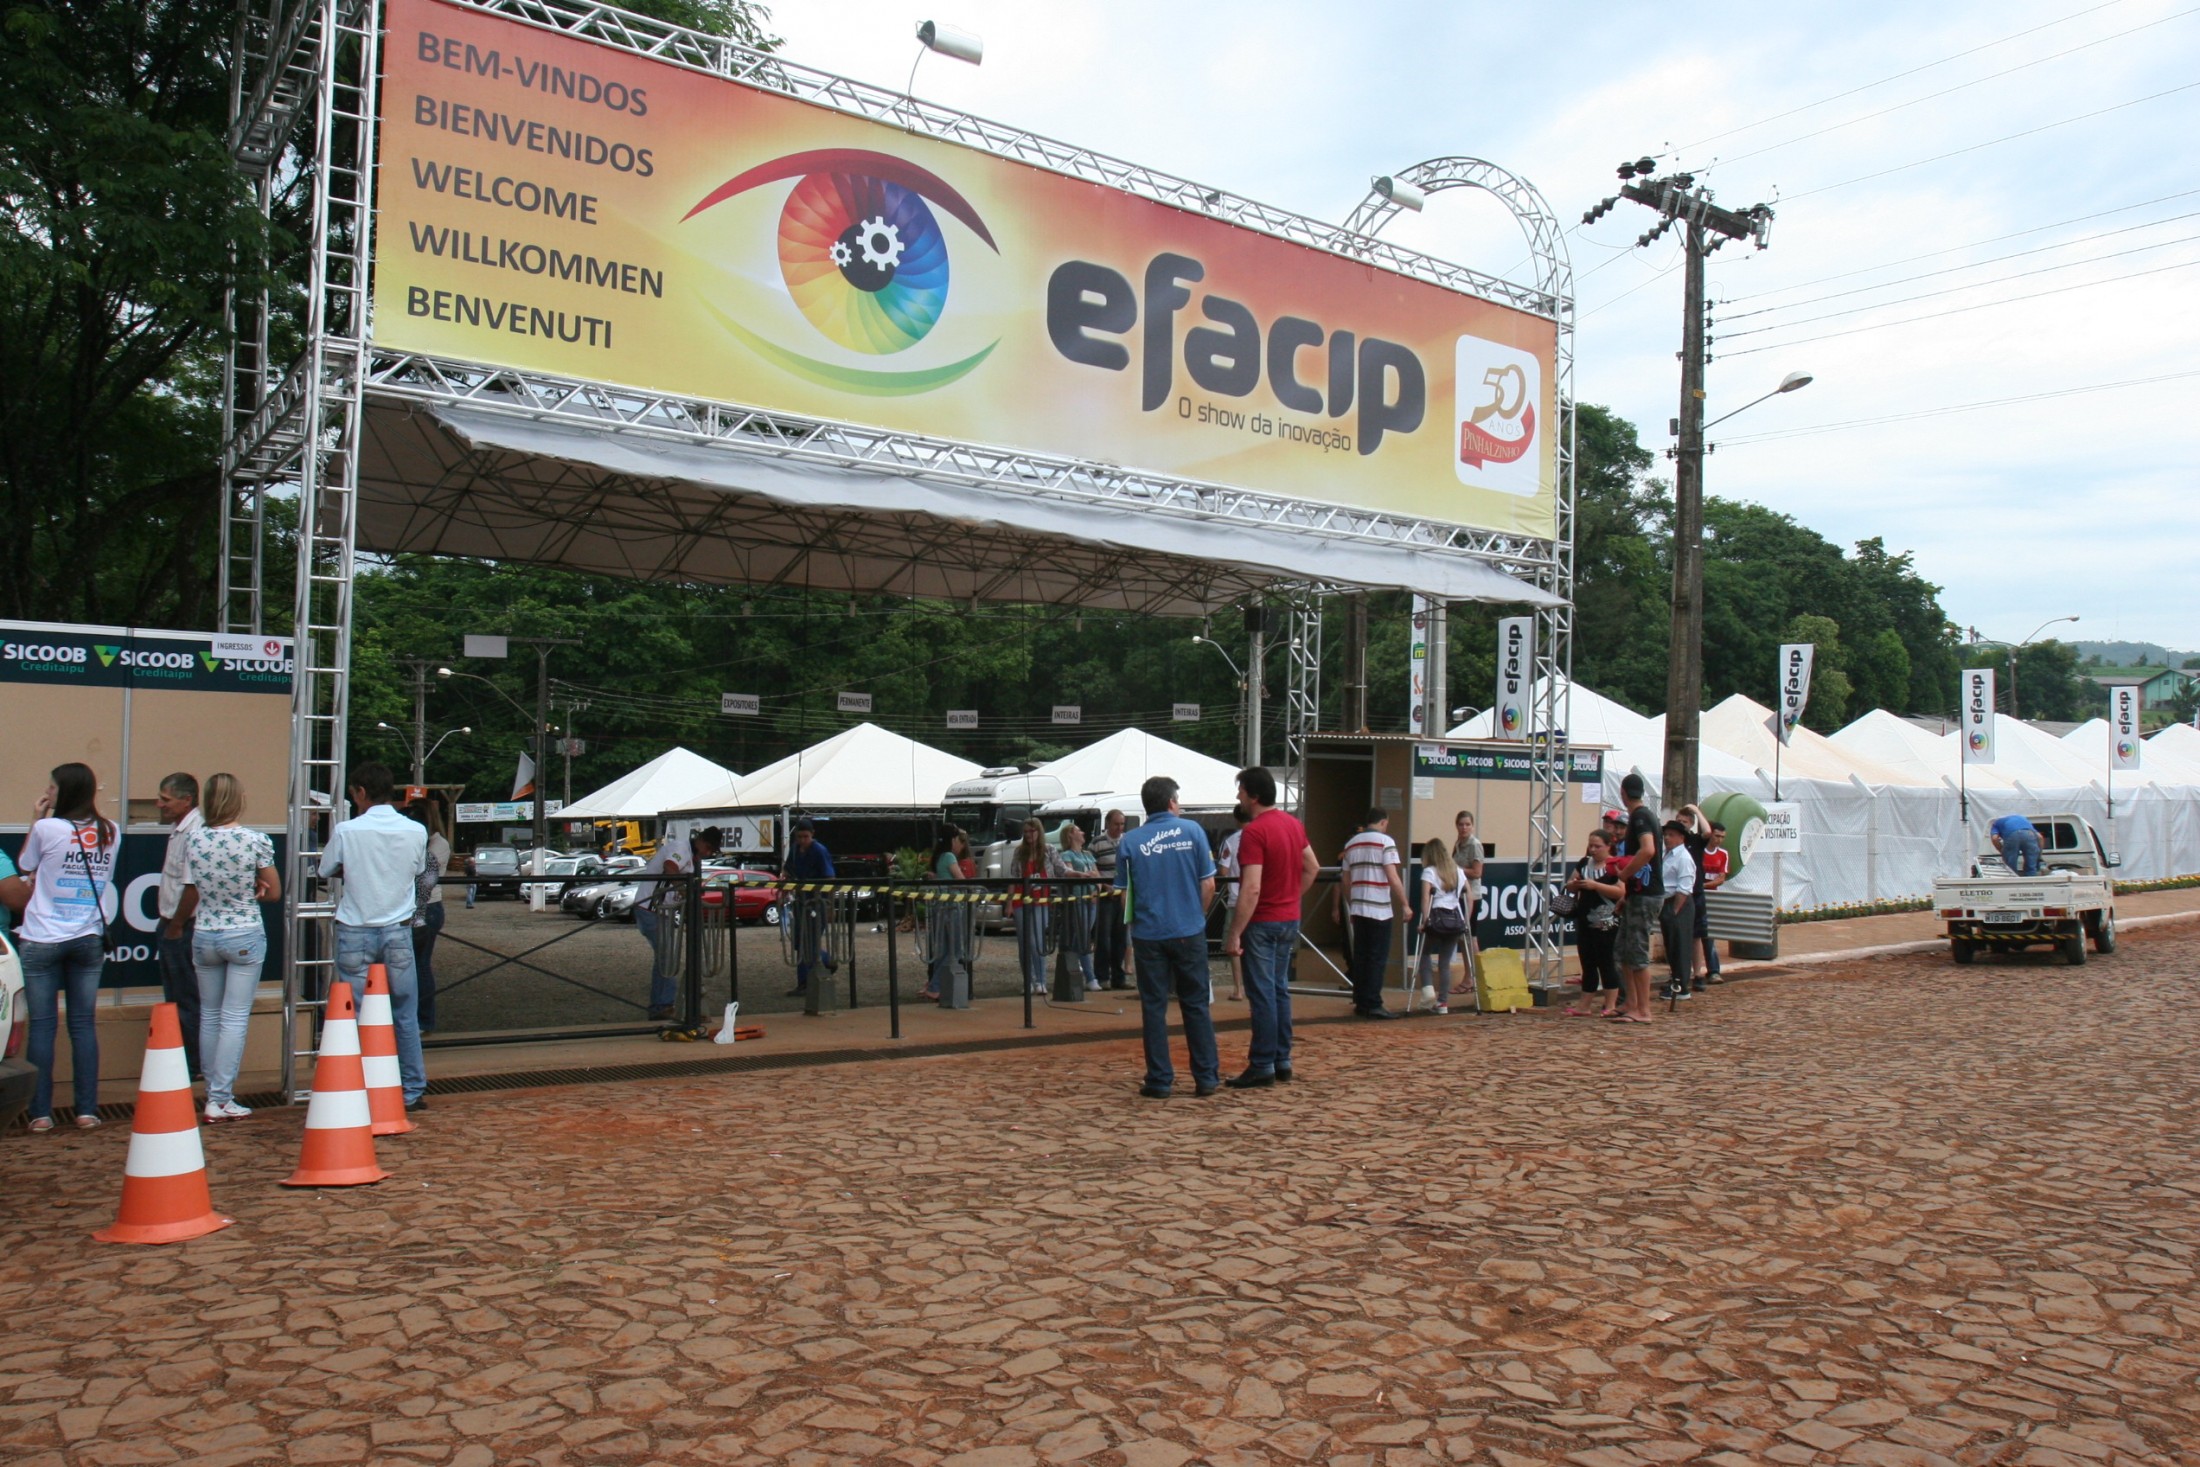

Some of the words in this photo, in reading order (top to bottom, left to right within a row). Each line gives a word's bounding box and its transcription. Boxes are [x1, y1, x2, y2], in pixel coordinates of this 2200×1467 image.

[417, 31, 648, 116] BEM-VINDOS
[414, 94, 654, 177] BIENVENIDOS
[411, 157, 598, 225] WELCOME
[408, 220, 663, 299] WILLKOMMEN
[407, 285, 612, 349] BENVENUTI
[1046, 252, 1426, 456] efacip
[1470, 363, 1527, 424] 50
[1178, 396, 1192, 419] O
[1197, 402, 1246, 430] show
[1251, 413, 1272, 436] da
[1278, 416, 1351, 453] inovação
[1488, 419, 1521, 437] ANOS
[1463, 428, 1520, 459] PINHALZINHO
[3, 643, 87, 663] SICOOB
[217, 642, 253, 651] INGRESSOS
[21, 661, 85, 674] Creditaipu
[120, 650, 194, 669] SICOOB
[1504, 624, 1523, 694] efacip
[133, 667, 193, 679] Creditaipu
[1784, 649, 1804, 708] efacip
[723, 699, 758, 711] EXPOSITORES
[839, 696, 871, 709] PERMANENTE
[1970, 674, 1986, 725] efacip
[1054, 711, 1079, 720] INTEIRAS
[1175, 708, 1199, 717] INTEIRAS
[2118, 691, 2133, 735] efacip
[1467, 756, 1494, 767] SICOOB
[1503, 758, 1531, 768] SICOOB
[1764, 828, 1797, 839] VISITANTES
[1163, 840, 1193, 850] SICOOB
[64, 851, 111, 865] HORUS
[1959, 889, 1993, 897] ELETRO
